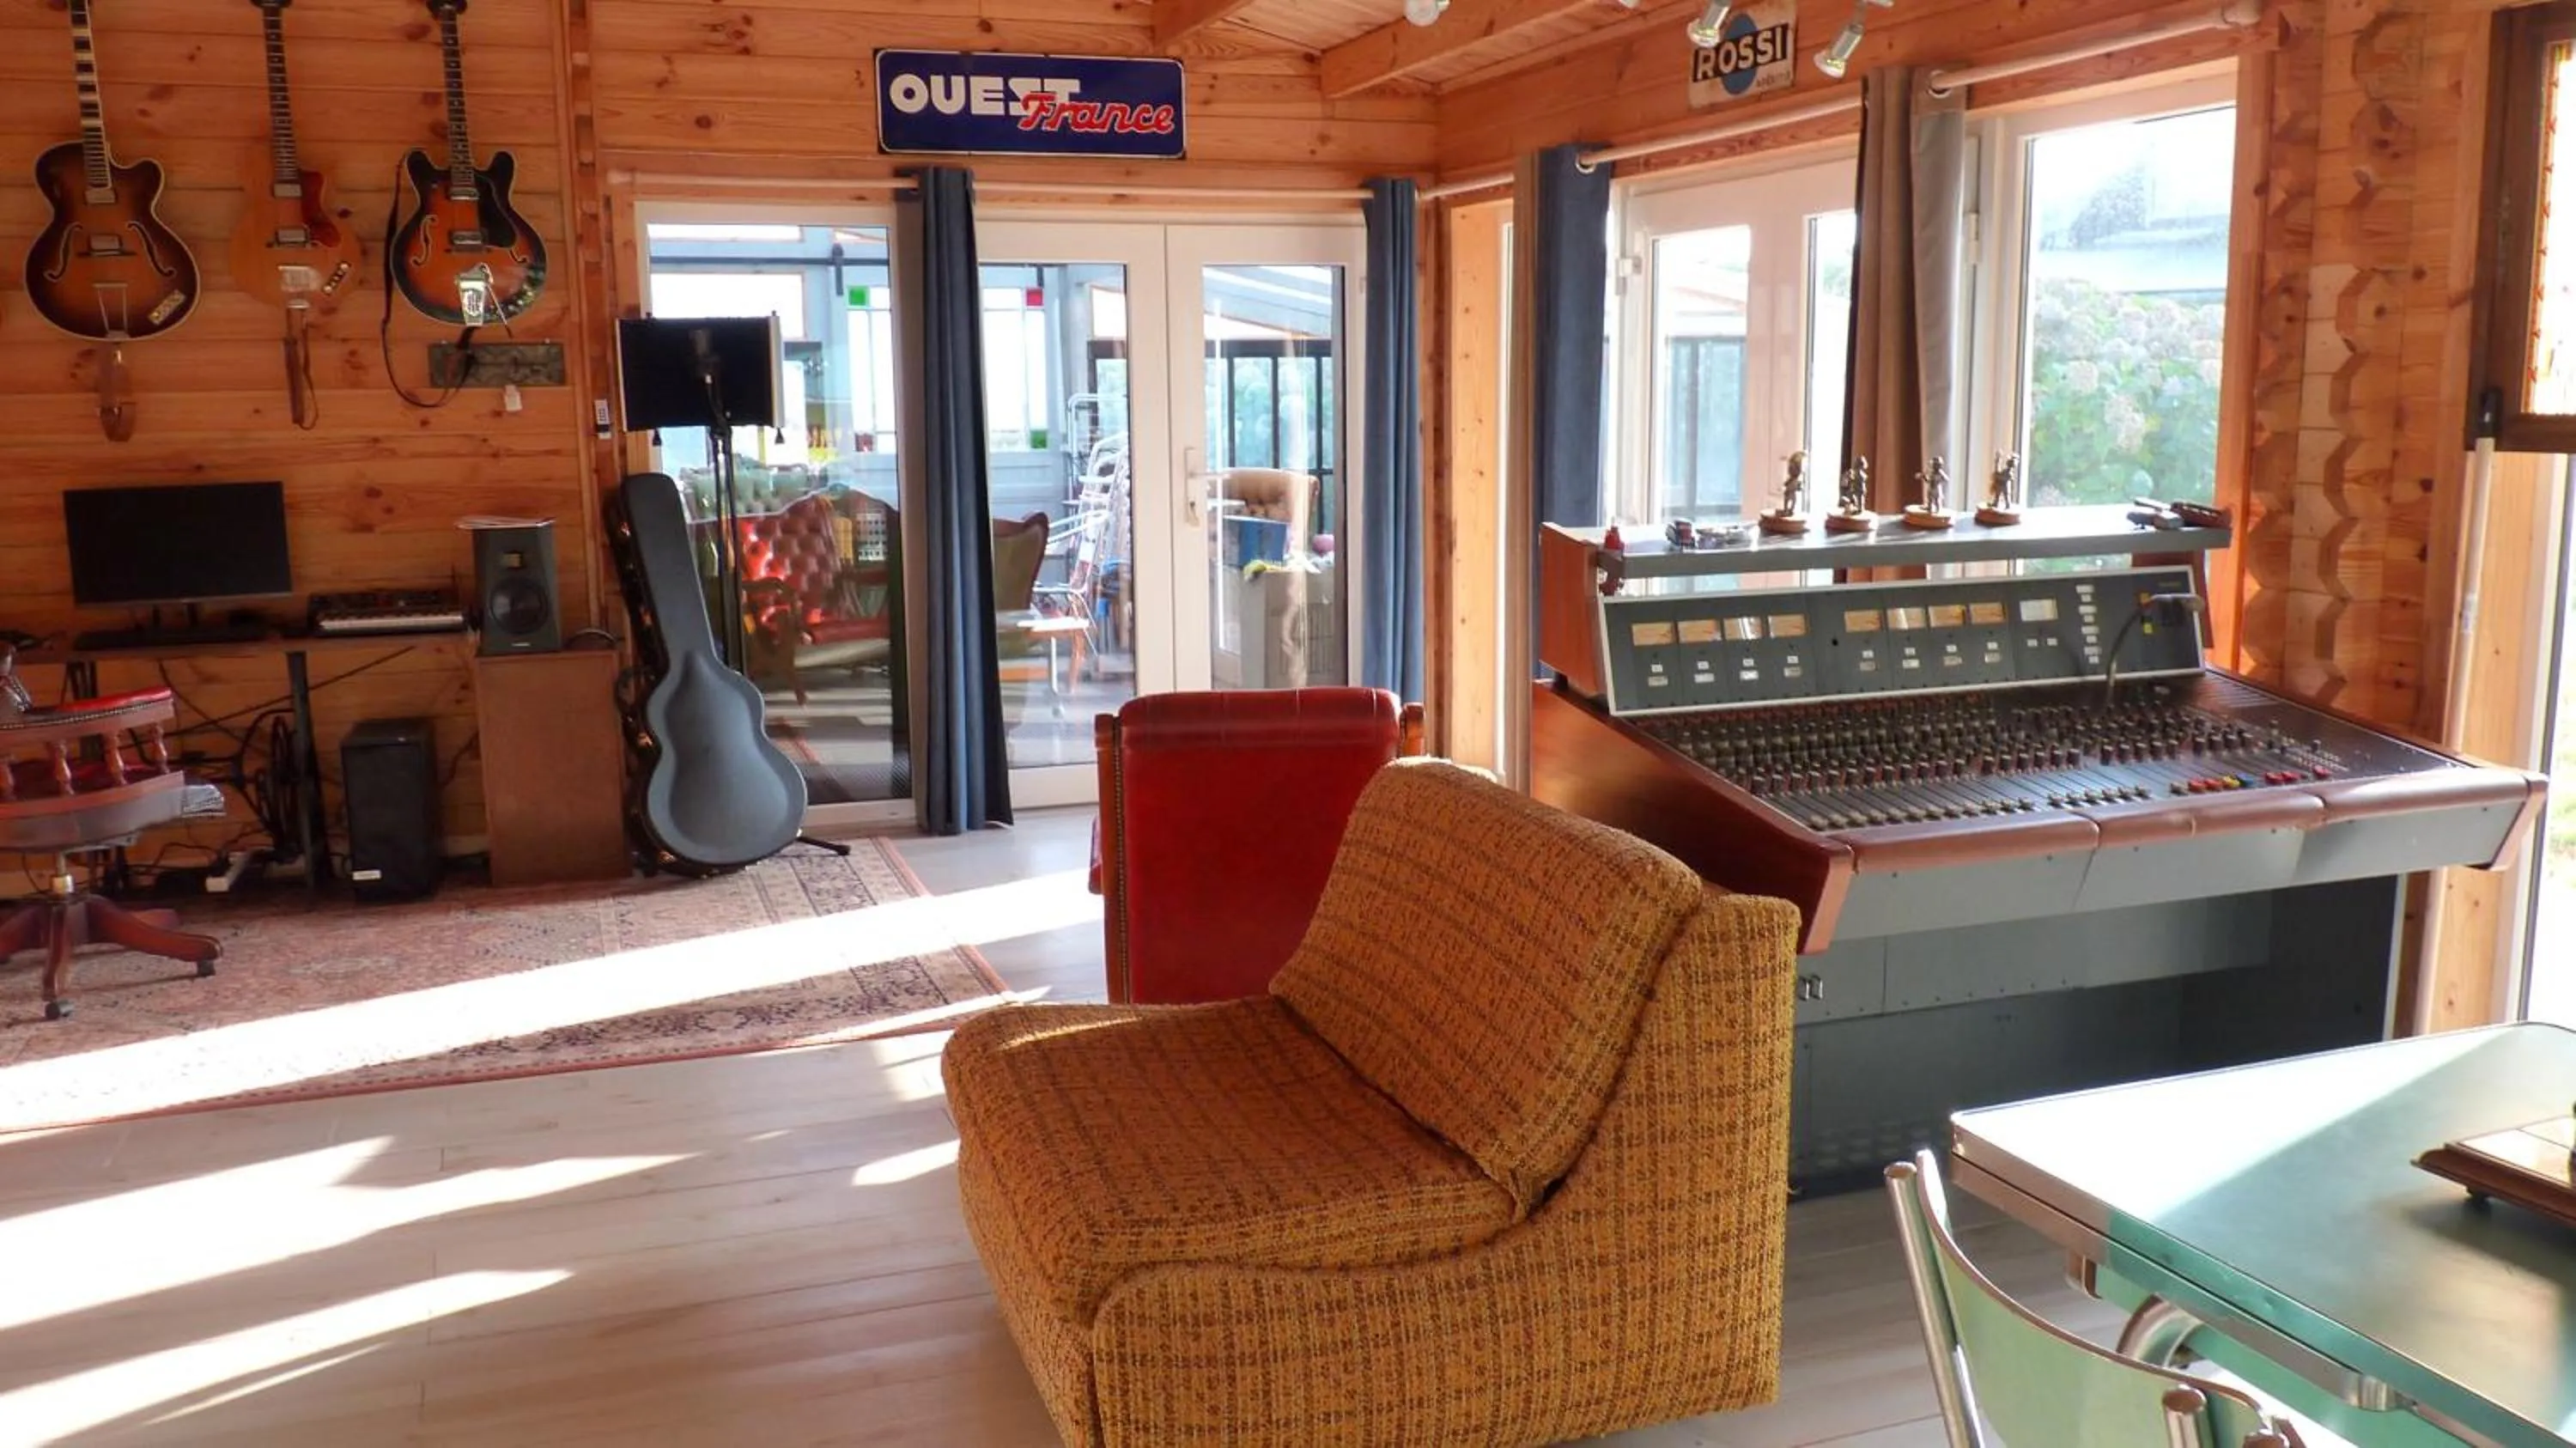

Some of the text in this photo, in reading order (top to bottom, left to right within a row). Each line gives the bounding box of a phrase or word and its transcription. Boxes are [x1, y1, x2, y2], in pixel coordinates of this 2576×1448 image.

[1697, 27, 1783, 81] ROSSI
[890, 73, 1080, 115] OUEST
[1018, 93, 1175, 134] France
